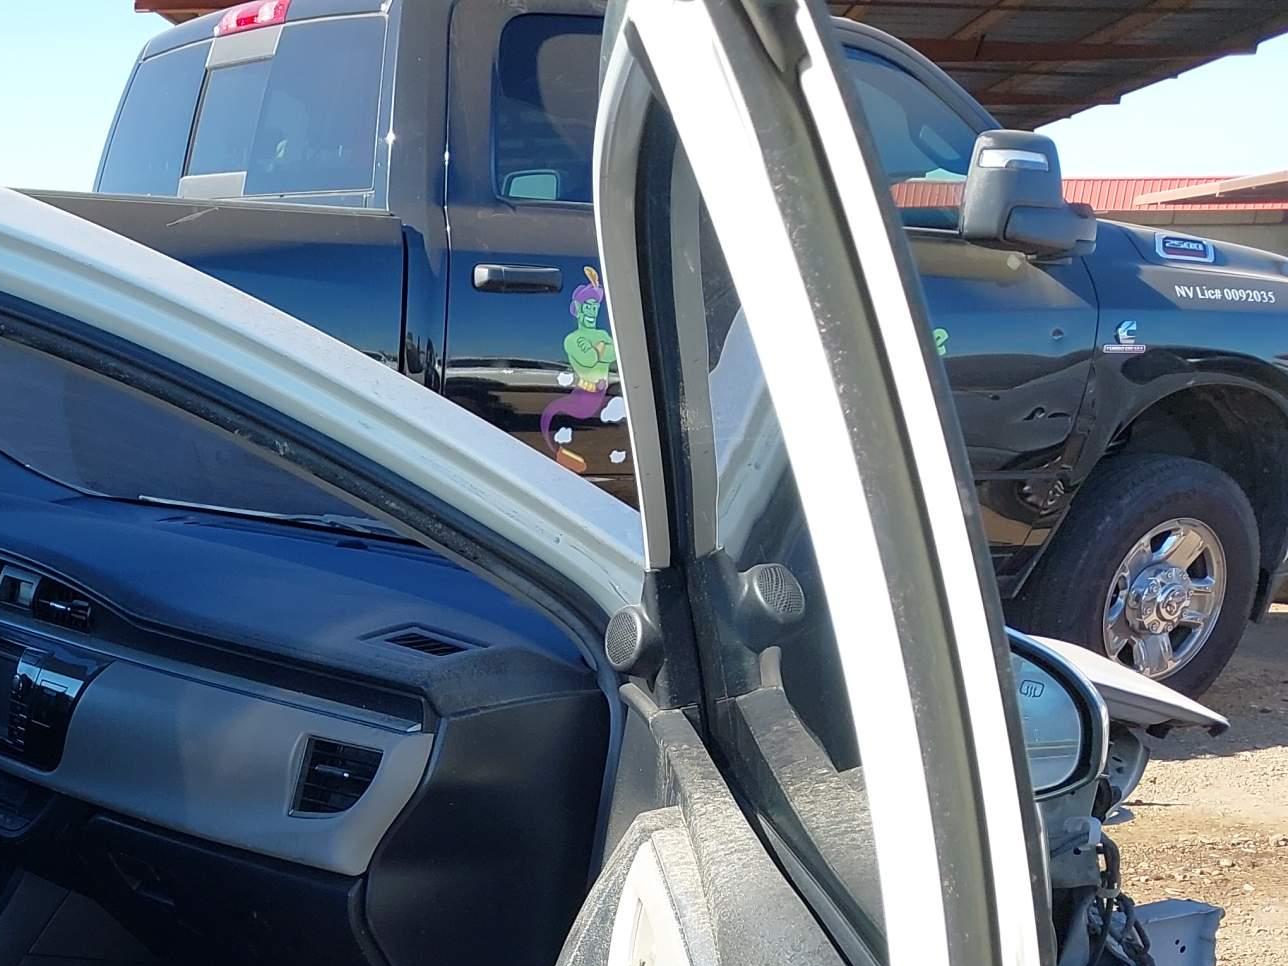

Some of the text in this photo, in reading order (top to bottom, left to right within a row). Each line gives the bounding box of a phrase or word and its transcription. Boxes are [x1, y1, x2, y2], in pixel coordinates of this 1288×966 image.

[1164, 239, 1204, 251] 2500
[1174, 285, 1276, 304] NV Lic# 0092035
